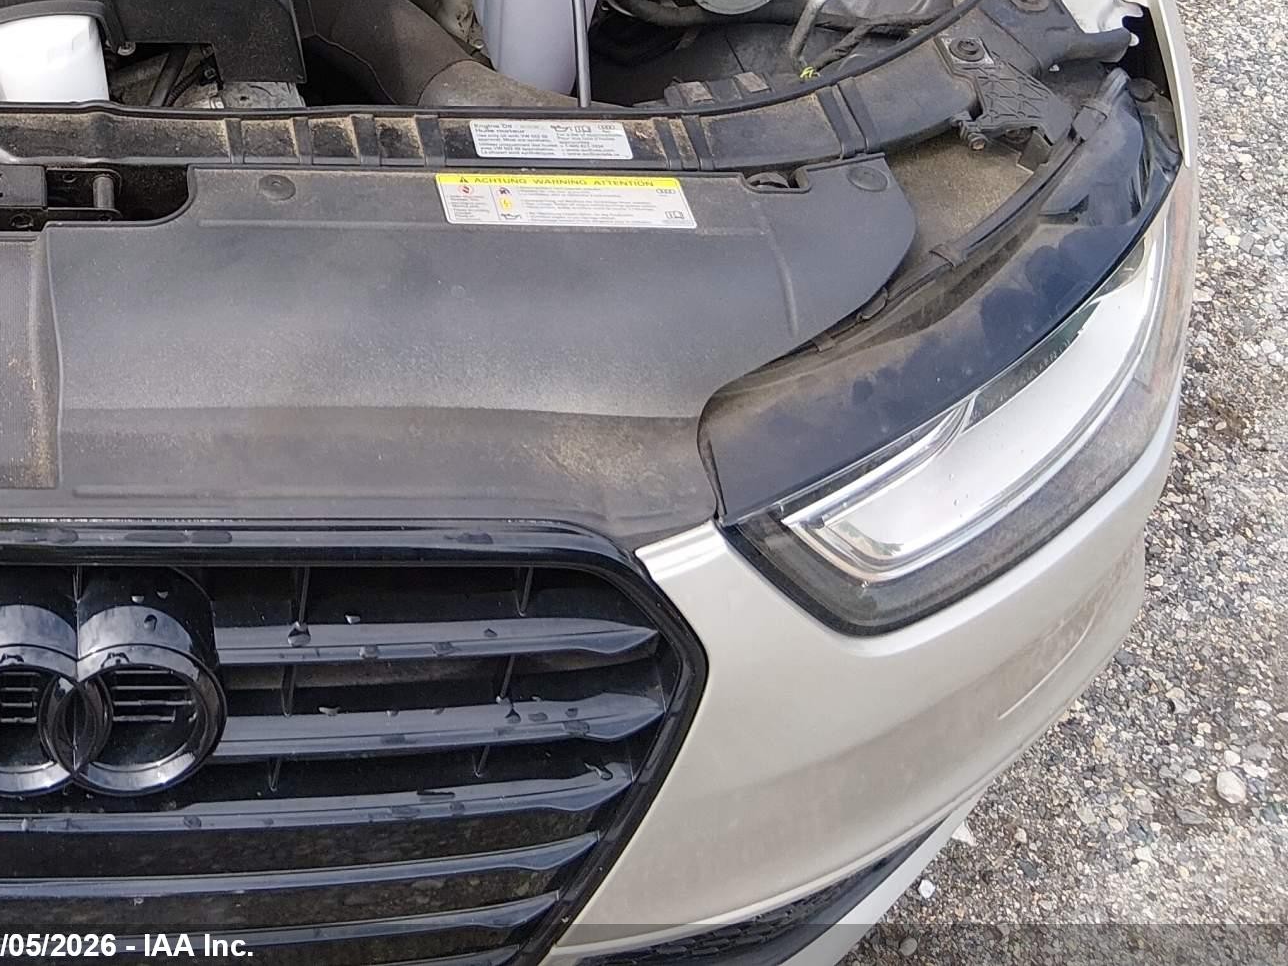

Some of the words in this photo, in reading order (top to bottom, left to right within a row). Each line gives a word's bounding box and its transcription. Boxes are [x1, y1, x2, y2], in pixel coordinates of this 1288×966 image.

[474, 177, 527, 185] ACHTUNG
[533, 178, 588, 186] WARNING
[593, 179, 654, 187] ATTENTION
